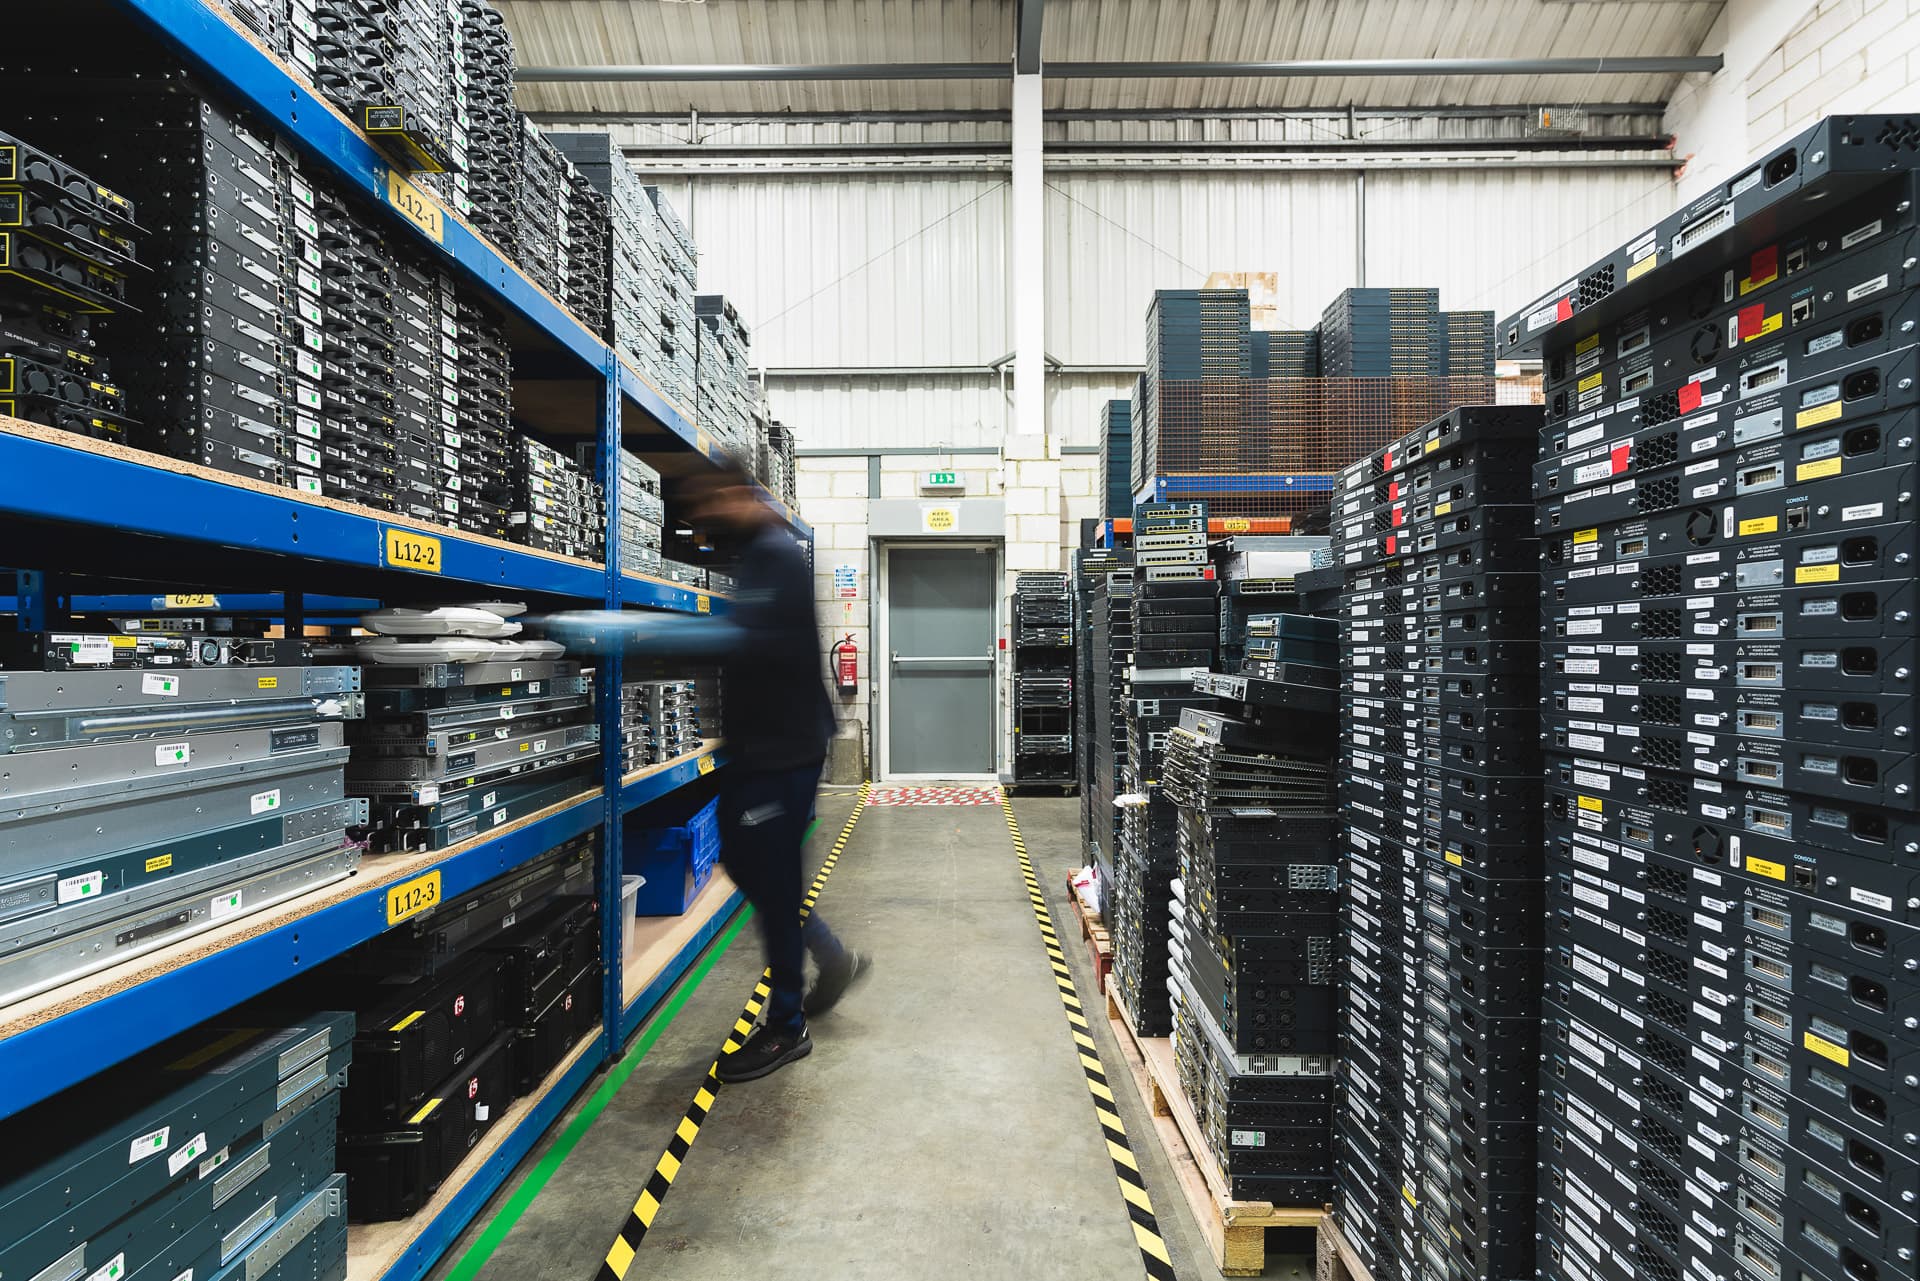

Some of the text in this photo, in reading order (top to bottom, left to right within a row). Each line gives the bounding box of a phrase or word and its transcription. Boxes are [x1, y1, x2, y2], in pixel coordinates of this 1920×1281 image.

[395, 183, 437, 233] L12-1
[1786, 495, 1809, 504] CONSOLE
[394, 540, 435, 566] L12-2
[175, 593, 205, 605] G7-2
[1793, 853, 1817, 864] CONSOLE
[394, 882, 435, 916] L12-3
